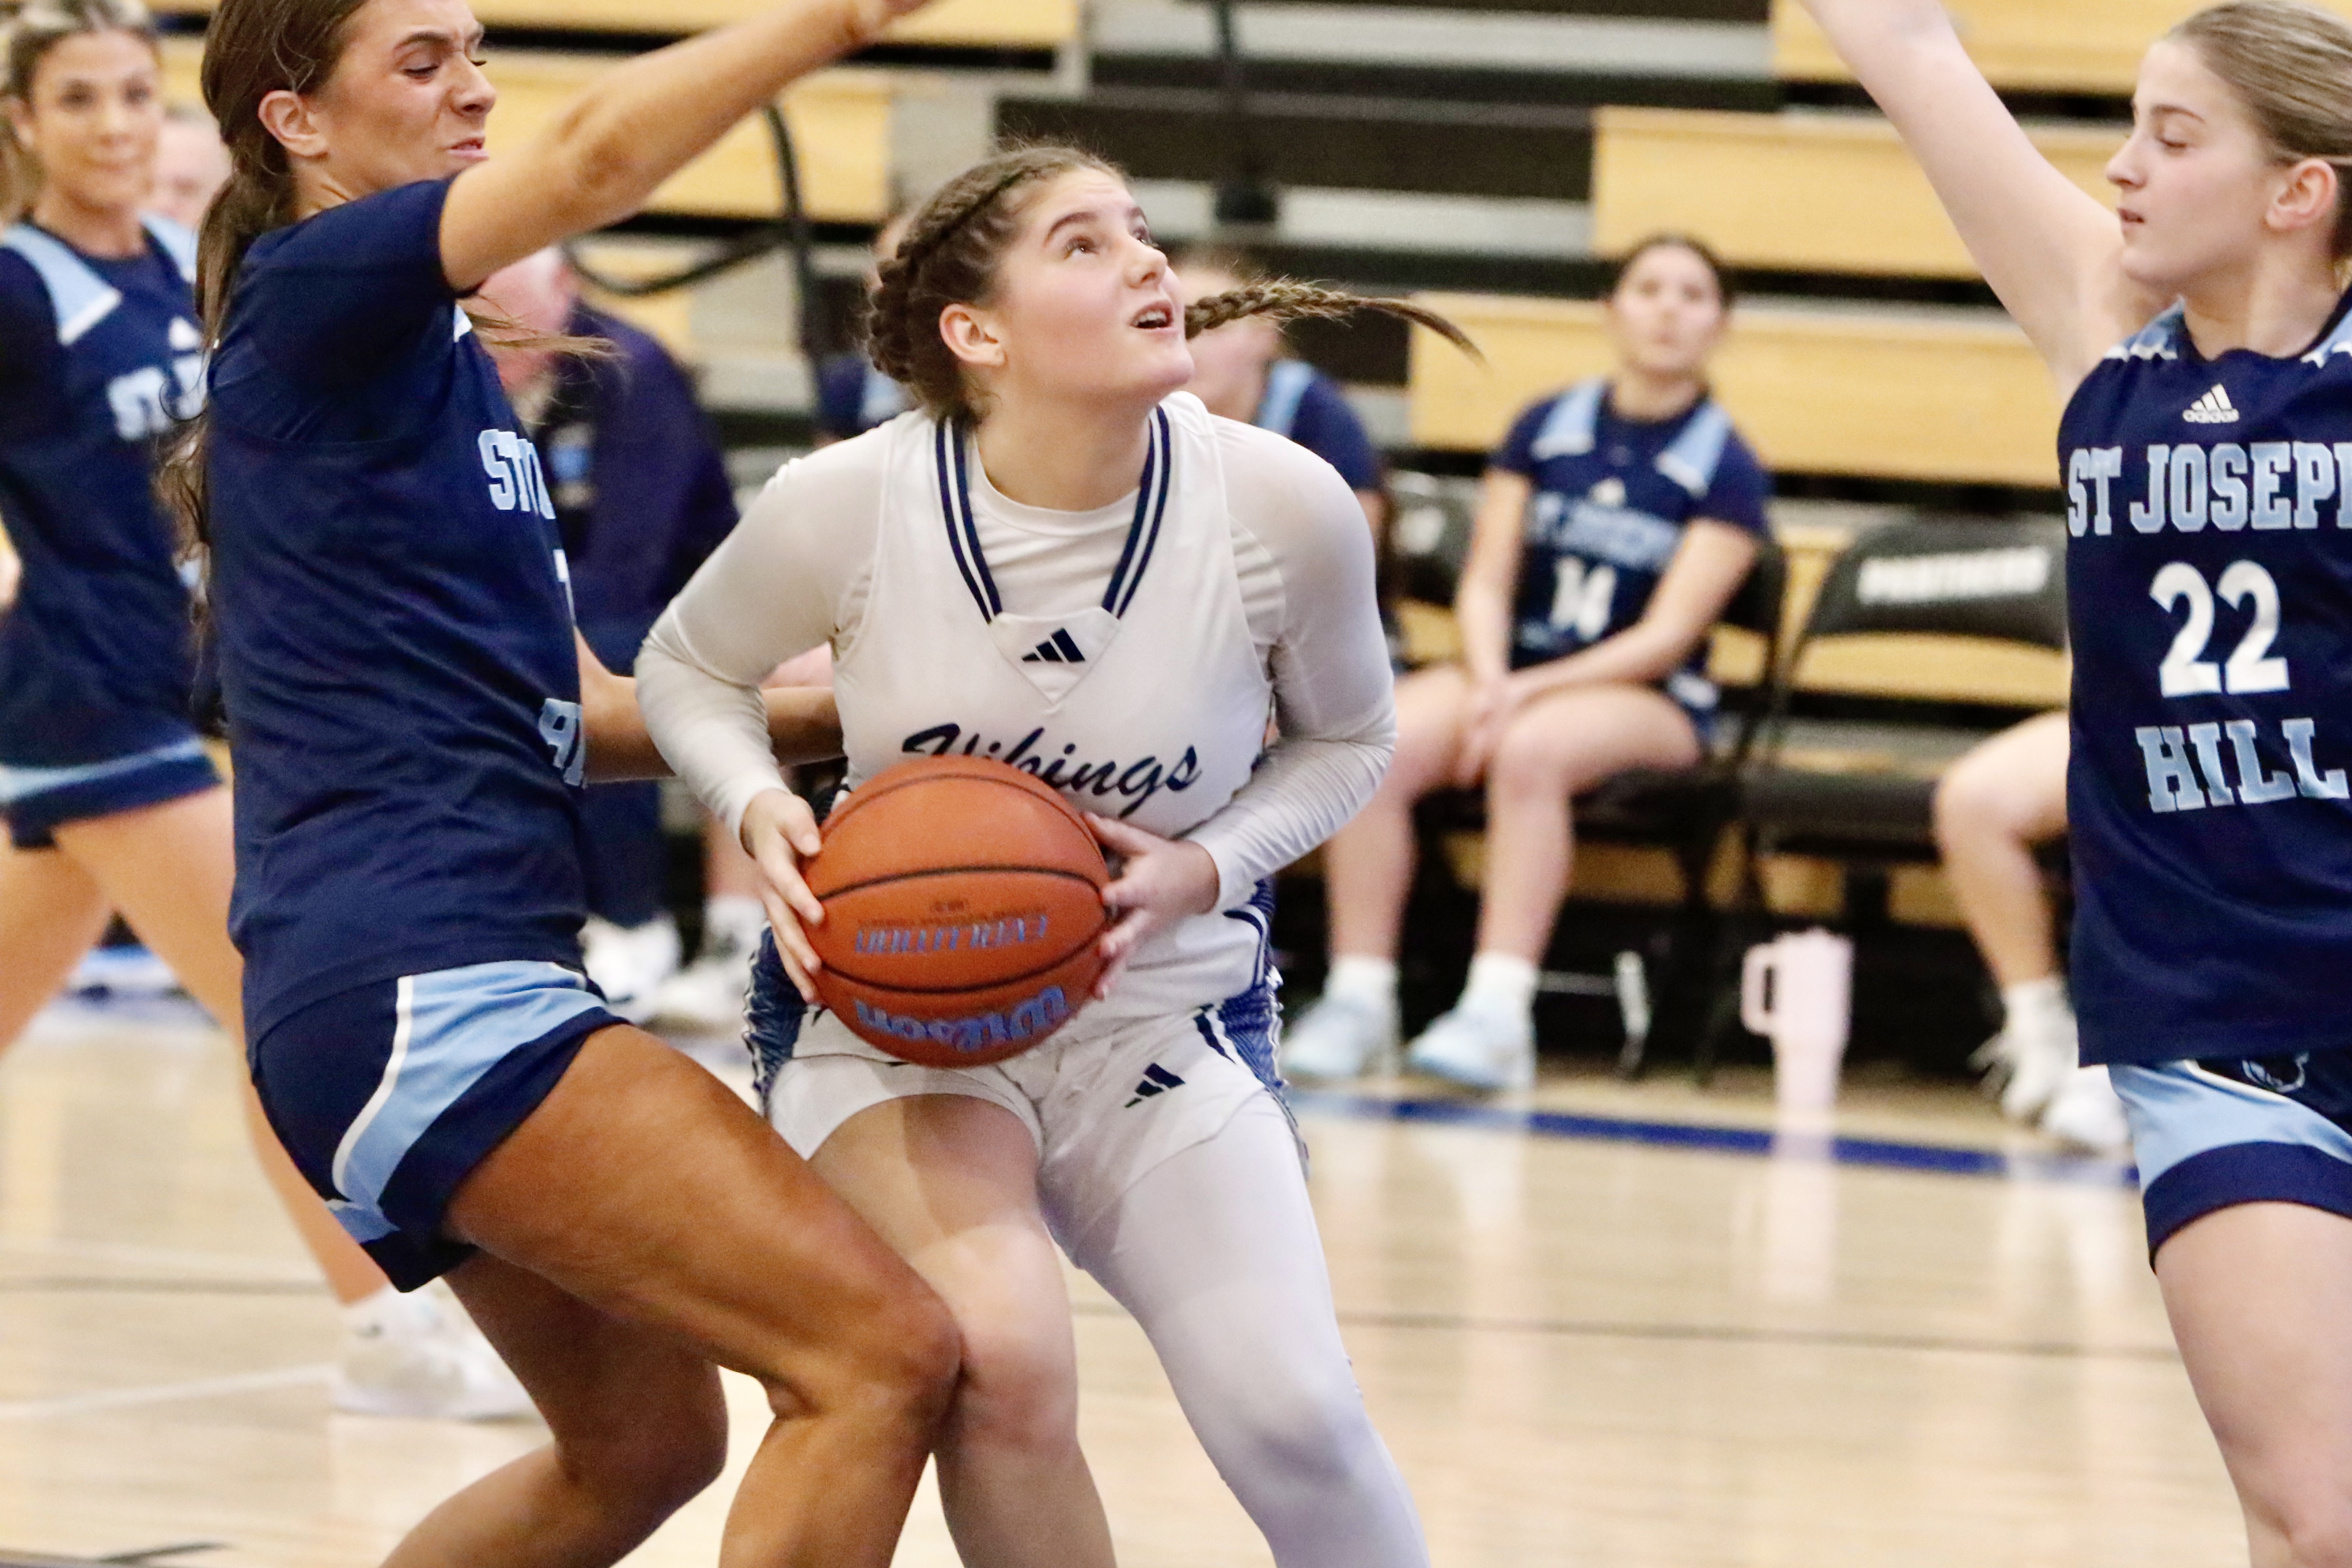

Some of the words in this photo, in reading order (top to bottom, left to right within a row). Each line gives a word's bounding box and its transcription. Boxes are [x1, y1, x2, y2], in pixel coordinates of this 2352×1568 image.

[2183, 408, 2239, 423] adidas
[2068, 445, 2122, 537] ST
[2149, 560, 2290, 698] 22
[902, 722, 1203, 819] Vkings
[2135, 717, 2350, 814] HILL
